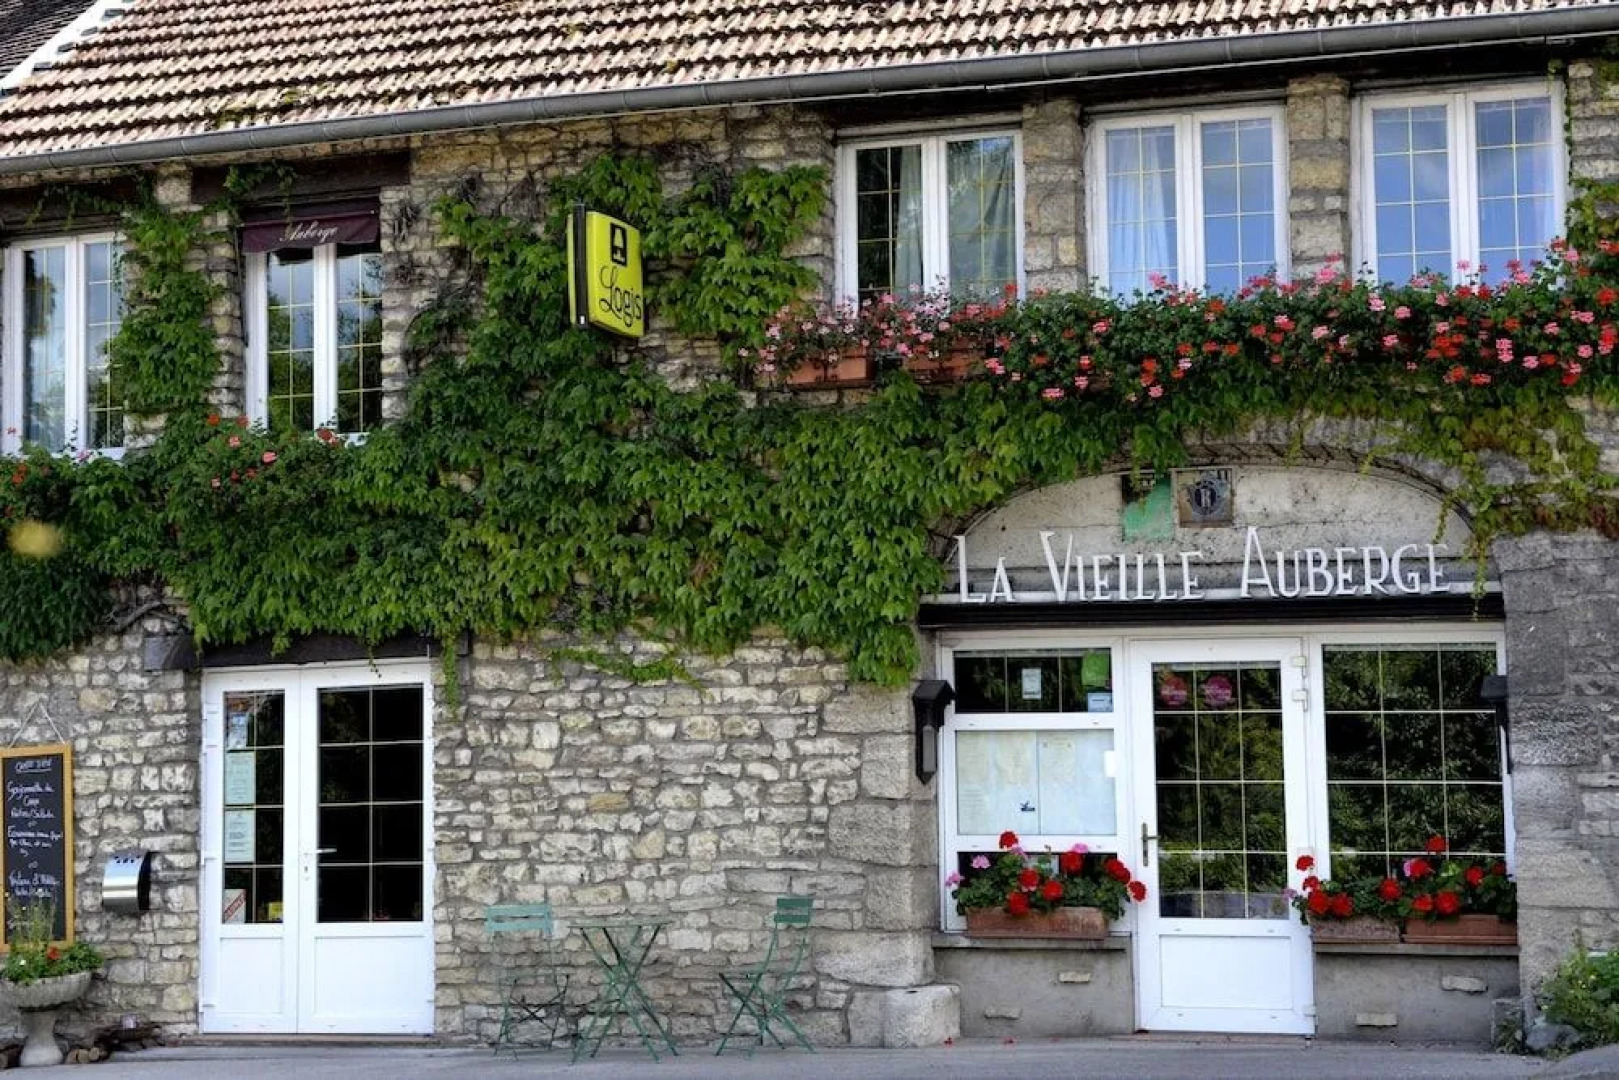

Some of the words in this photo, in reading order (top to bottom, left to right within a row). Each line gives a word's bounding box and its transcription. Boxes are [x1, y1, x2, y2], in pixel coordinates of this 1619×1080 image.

[599, 265, 641, 328] Logis
[954, 535, 1016, 603] LA
[1039, 530, 1206, 603] VIEILLE
[1240, 525, 1451, 599] AUBERGE
